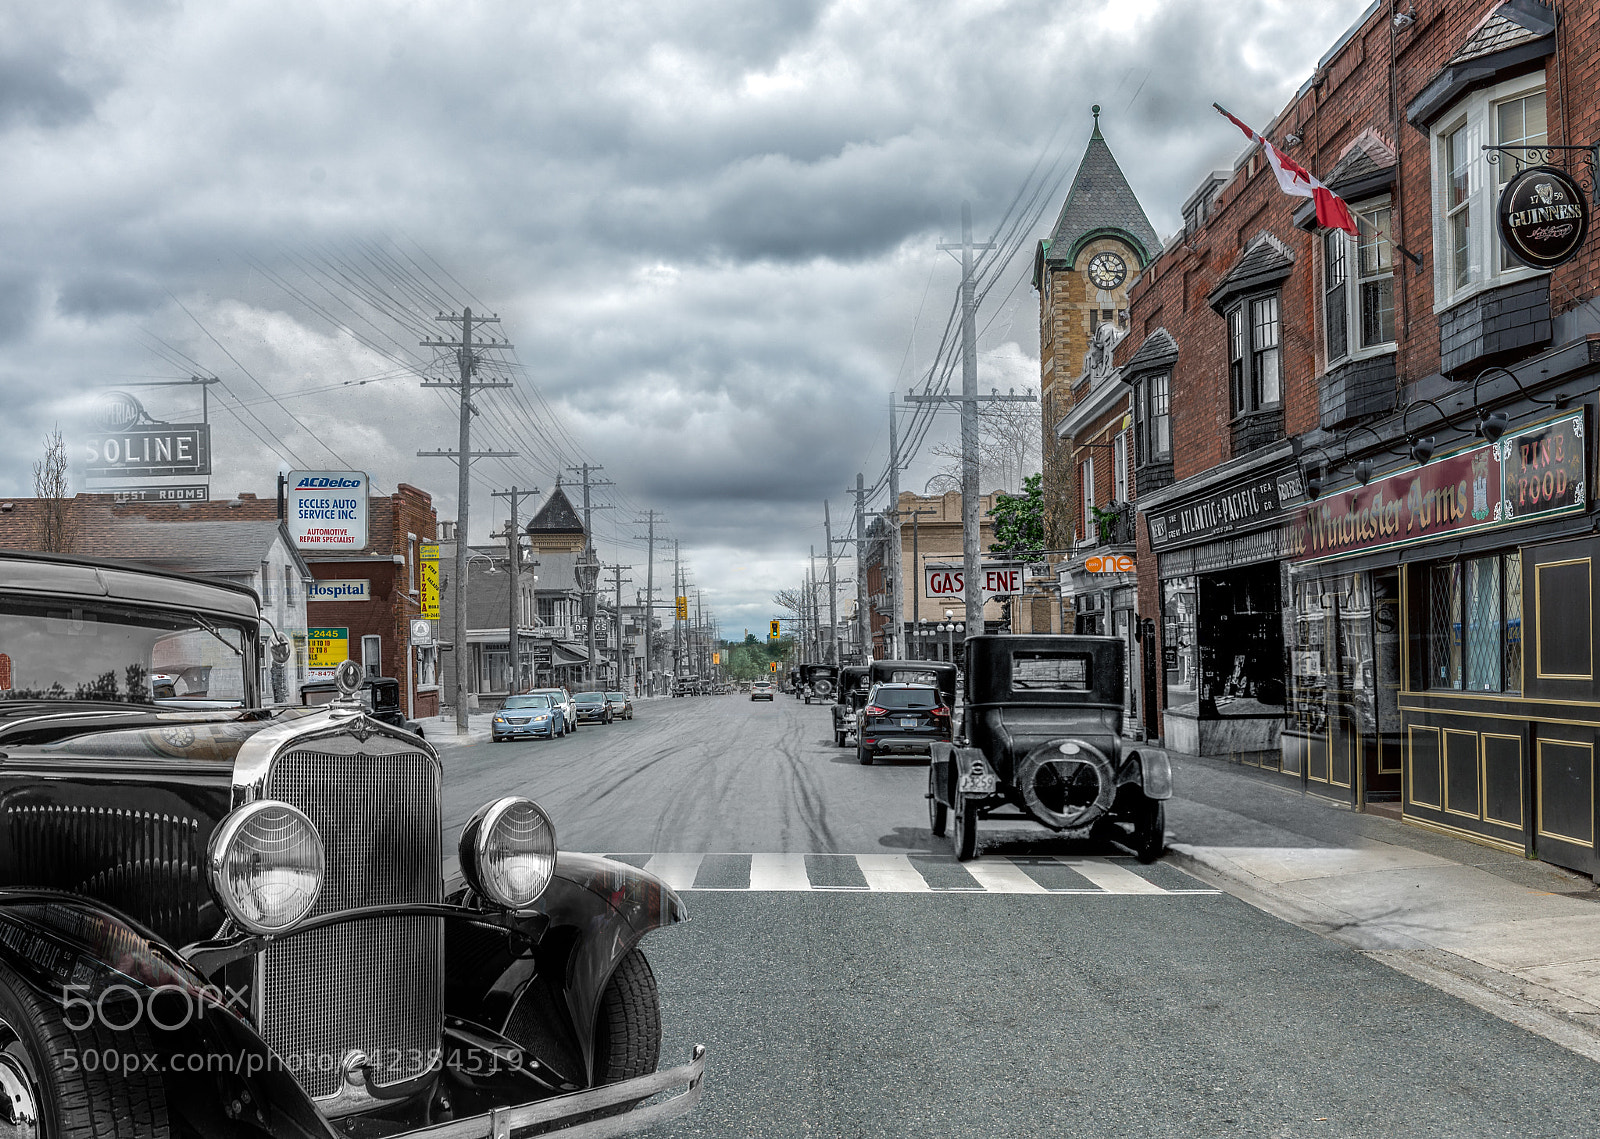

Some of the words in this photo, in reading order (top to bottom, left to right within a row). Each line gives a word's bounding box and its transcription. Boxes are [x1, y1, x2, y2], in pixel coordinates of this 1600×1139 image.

[1530, 195, 1539, 205] 17
[1554, 192, 1564, 201] 59
[1508, 203, 1582, 228] GUINNESS
[1519, 435, 1565, 474] FINE
[297, 477, 361, 488] ACDelco
[1260, 483, 1272, 494] TEA
[1517, 467, 1567, 507] FOOD
[113, 490, 146, 502] REST
[160, 489, 204, 500] ROOMS
[298, 499, 330, 509] ECCLES
[332, 499, 357, 509] AUTO
[1180, 501, 1218, 534] ATLANTIC
[1217, 504, 1223, 518] &
[1221, 487, 1260, 523] PACIFIC
[298, 510, 335, 519] SERVICE
[338, 510, 357, 520] INC.
[1168, 514, 1177, 523] THE
[1307, 484, 1402, 550] Winchester
[1407, 476, 1468, 533] Arms
[307, 528, 348, 536] AUTOMOTIVE
[322, 536, 355, 544] SPECIALIST
[930, 571, 1021, 594] GASENE
[309, 584, 365, 598] Hospital
